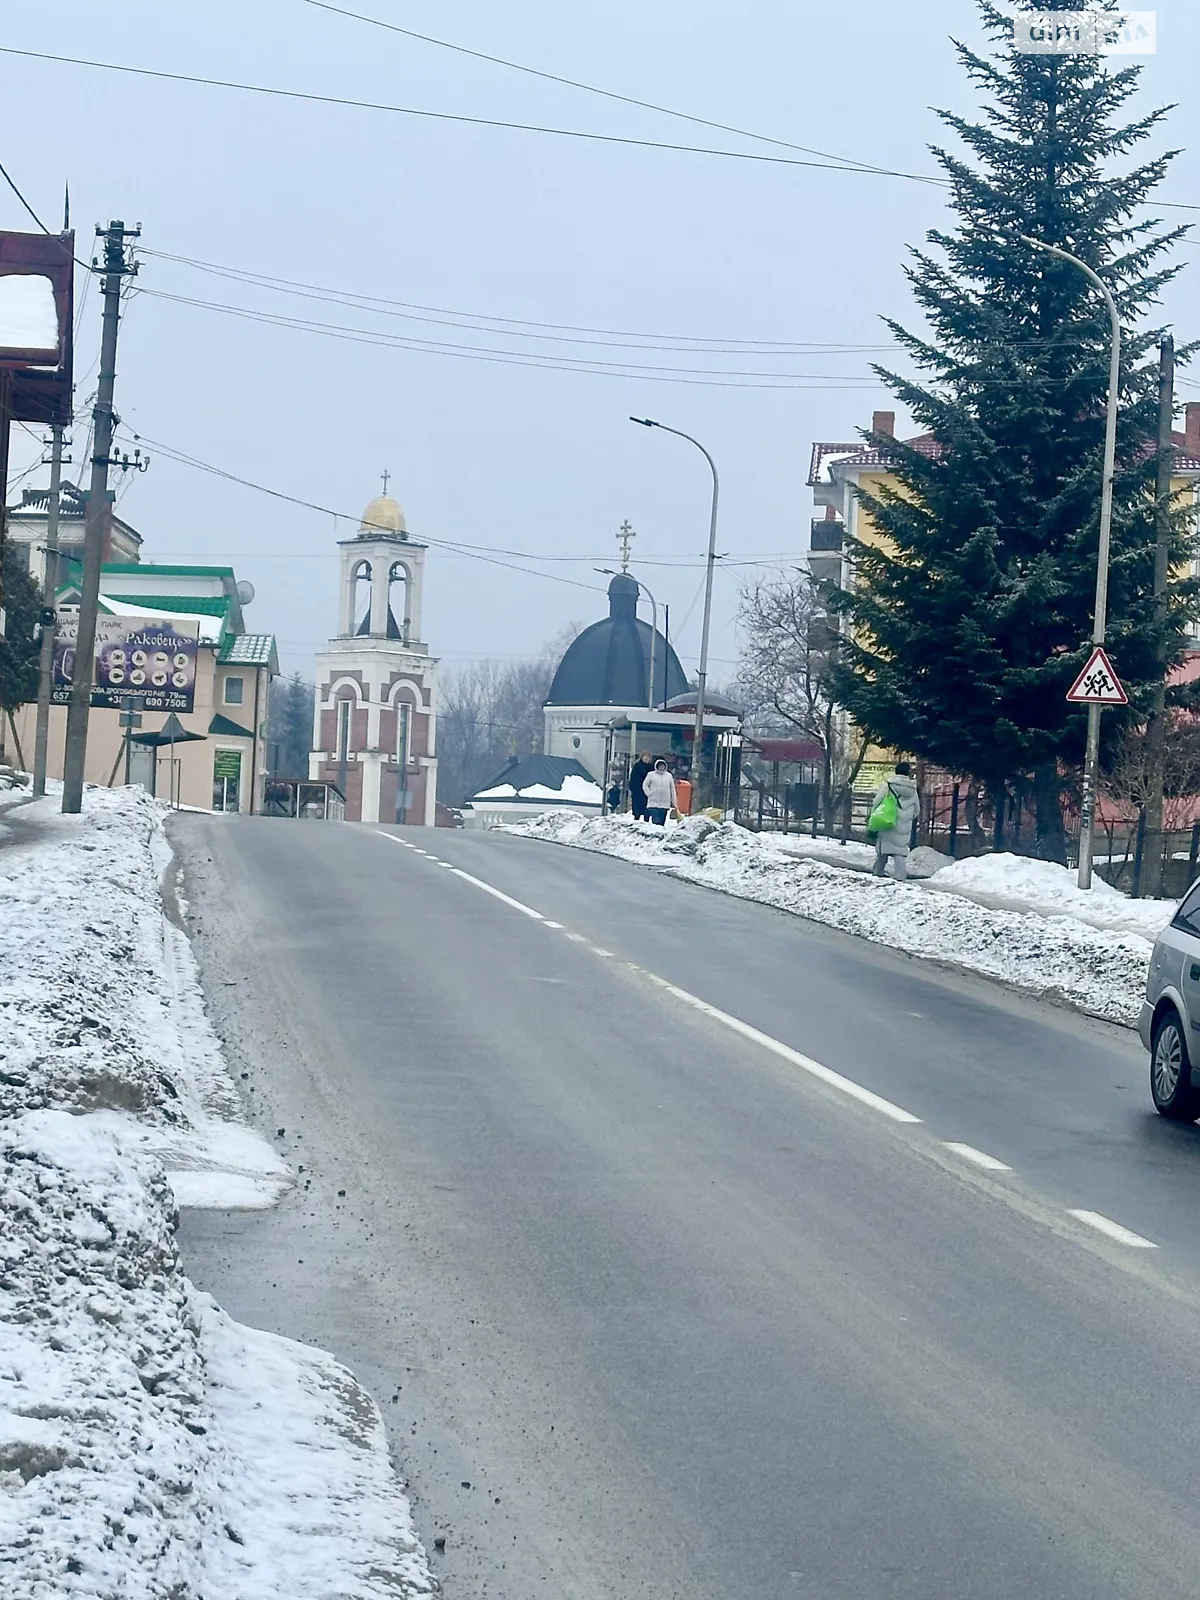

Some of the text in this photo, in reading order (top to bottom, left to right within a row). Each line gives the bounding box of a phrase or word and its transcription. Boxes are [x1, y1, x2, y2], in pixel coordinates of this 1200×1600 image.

[101, 621, 122, 629] ПАРК
[145, 697, 162, 706] 690
[164, 698, 187, 708] 7506
